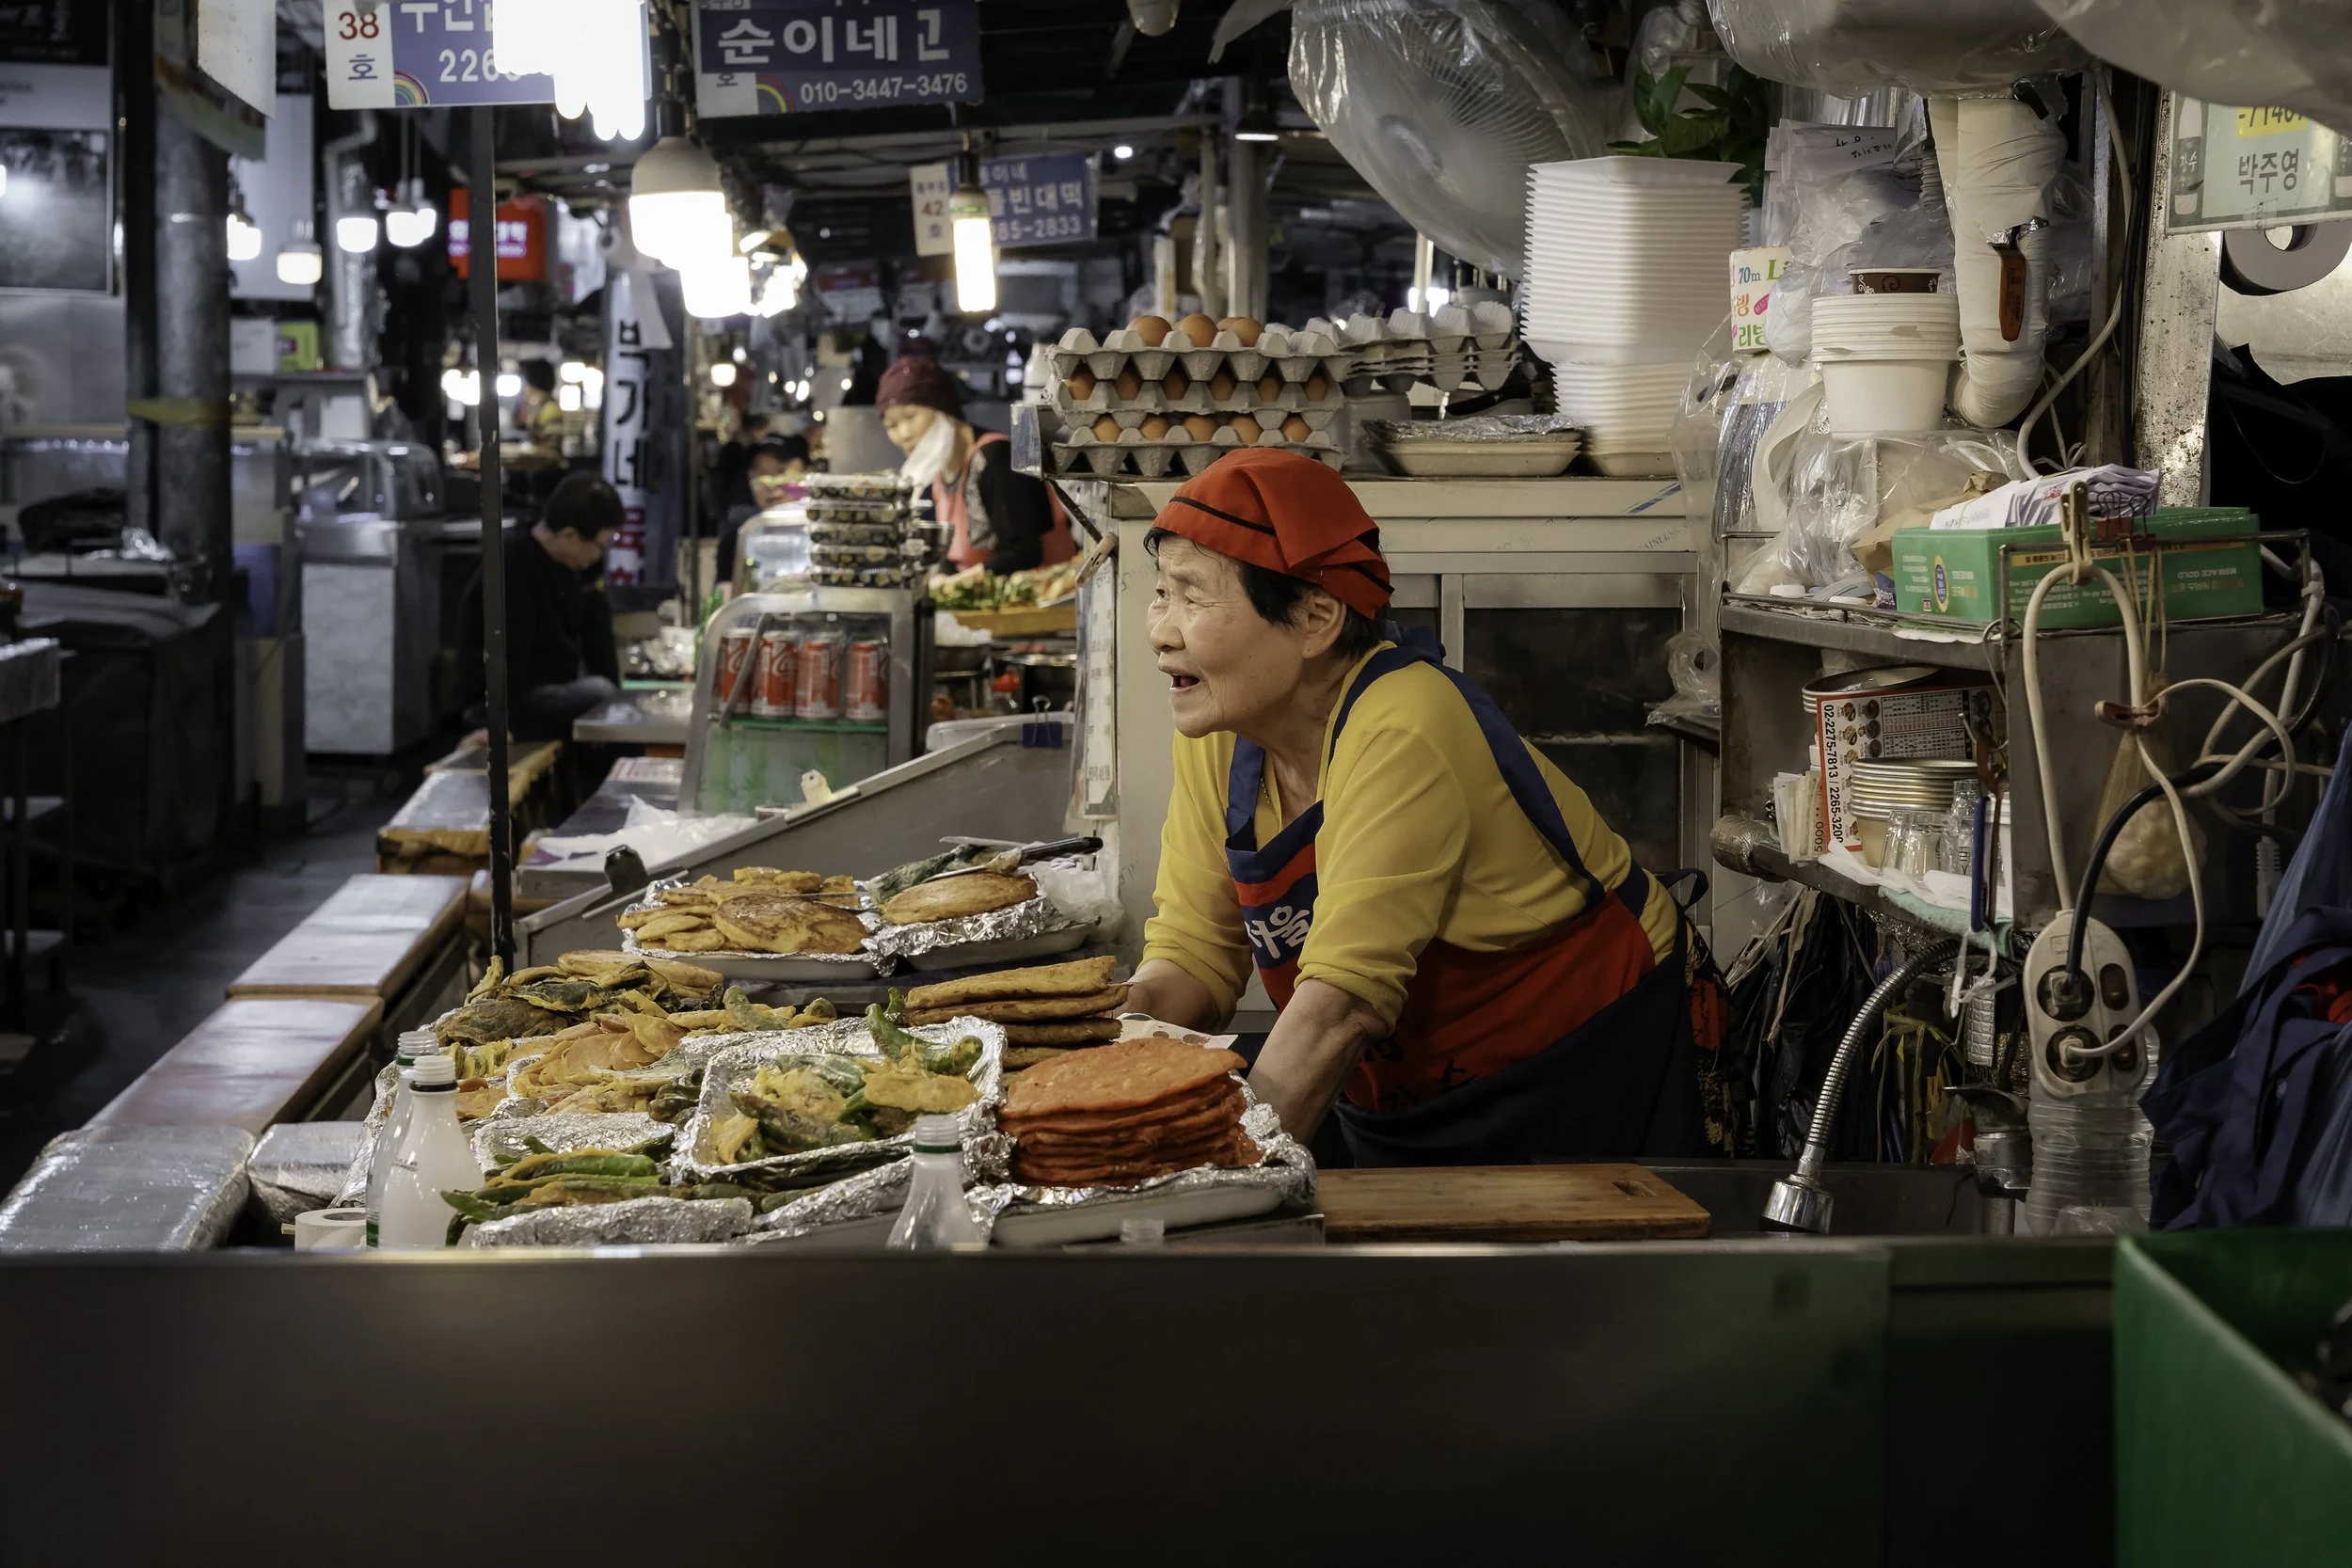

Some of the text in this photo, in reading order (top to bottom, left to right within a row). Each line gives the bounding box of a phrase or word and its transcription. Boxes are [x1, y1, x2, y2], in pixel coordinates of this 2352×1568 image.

[339, 11, 379, 40] 38
[717, 15, 898, 65] 순이네
[348, 54, 378, 81] 호
[439, 49, 523, 83] 226
[801, 73, 968, 103] 010-3447-3476
[2238, 148, 2299, 196] 박주영
[921, 199, 945, 216] 42
[2177, 570, 2200, 579] GOLD
[1823, 704, 1839, 779] 02-2275-7813
[1814, 820, 1824, 853] 5000
